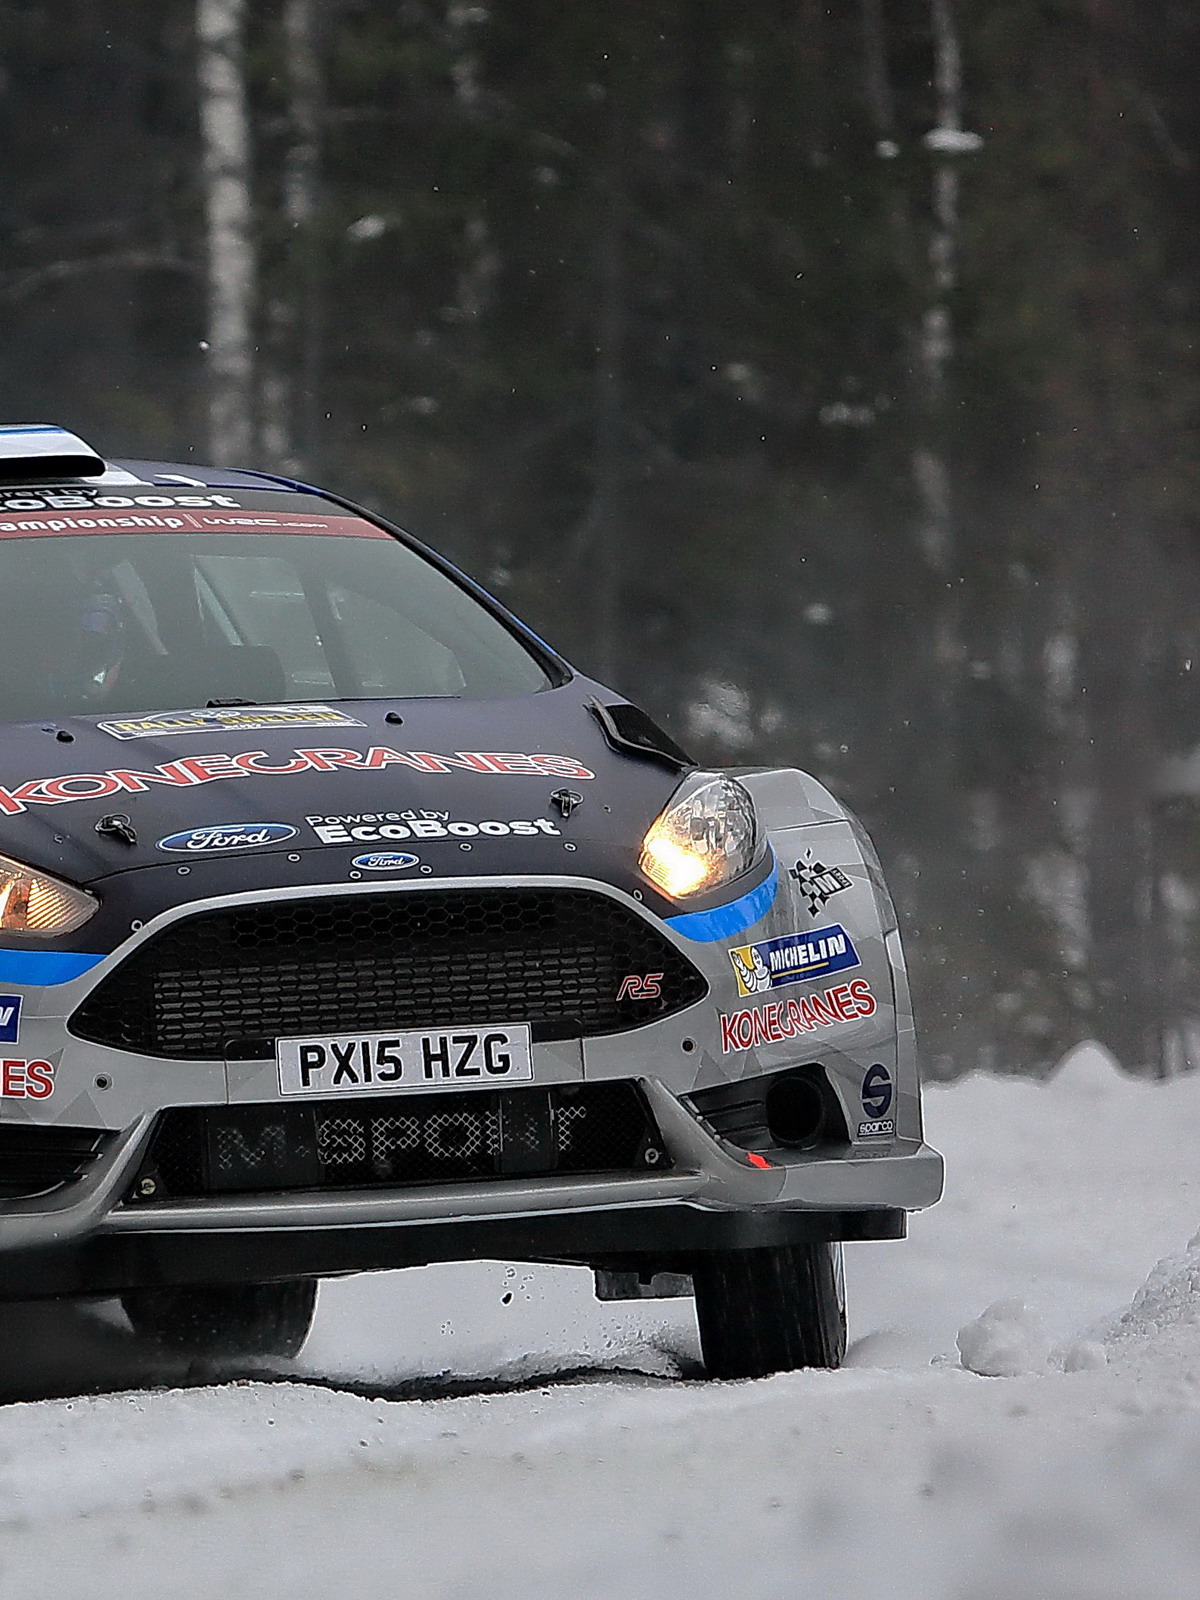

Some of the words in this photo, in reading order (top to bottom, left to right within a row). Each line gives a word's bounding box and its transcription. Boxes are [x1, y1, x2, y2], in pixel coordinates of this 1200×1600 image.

[61, 488, 99, 497] by
[116, 718, 207, 731] RALLY
[305, 811, 419, 826] Powered
[424, 809, 451, 823] by
[186, 830, 271, 851] Ford
[313, 817, 562, 845] EcoBoost
[367, 854, 406, 868] Ford
[813, 872, 842, 895] M
[770, 934, 847, 972] MICHELIN
[720, 978, 878, 1055] KONECRANES
[301, 1039, 402, 1087] PX15
[422, 1033, 511, 1079] HZG
[859, 1121, 893, 1135] sparco
